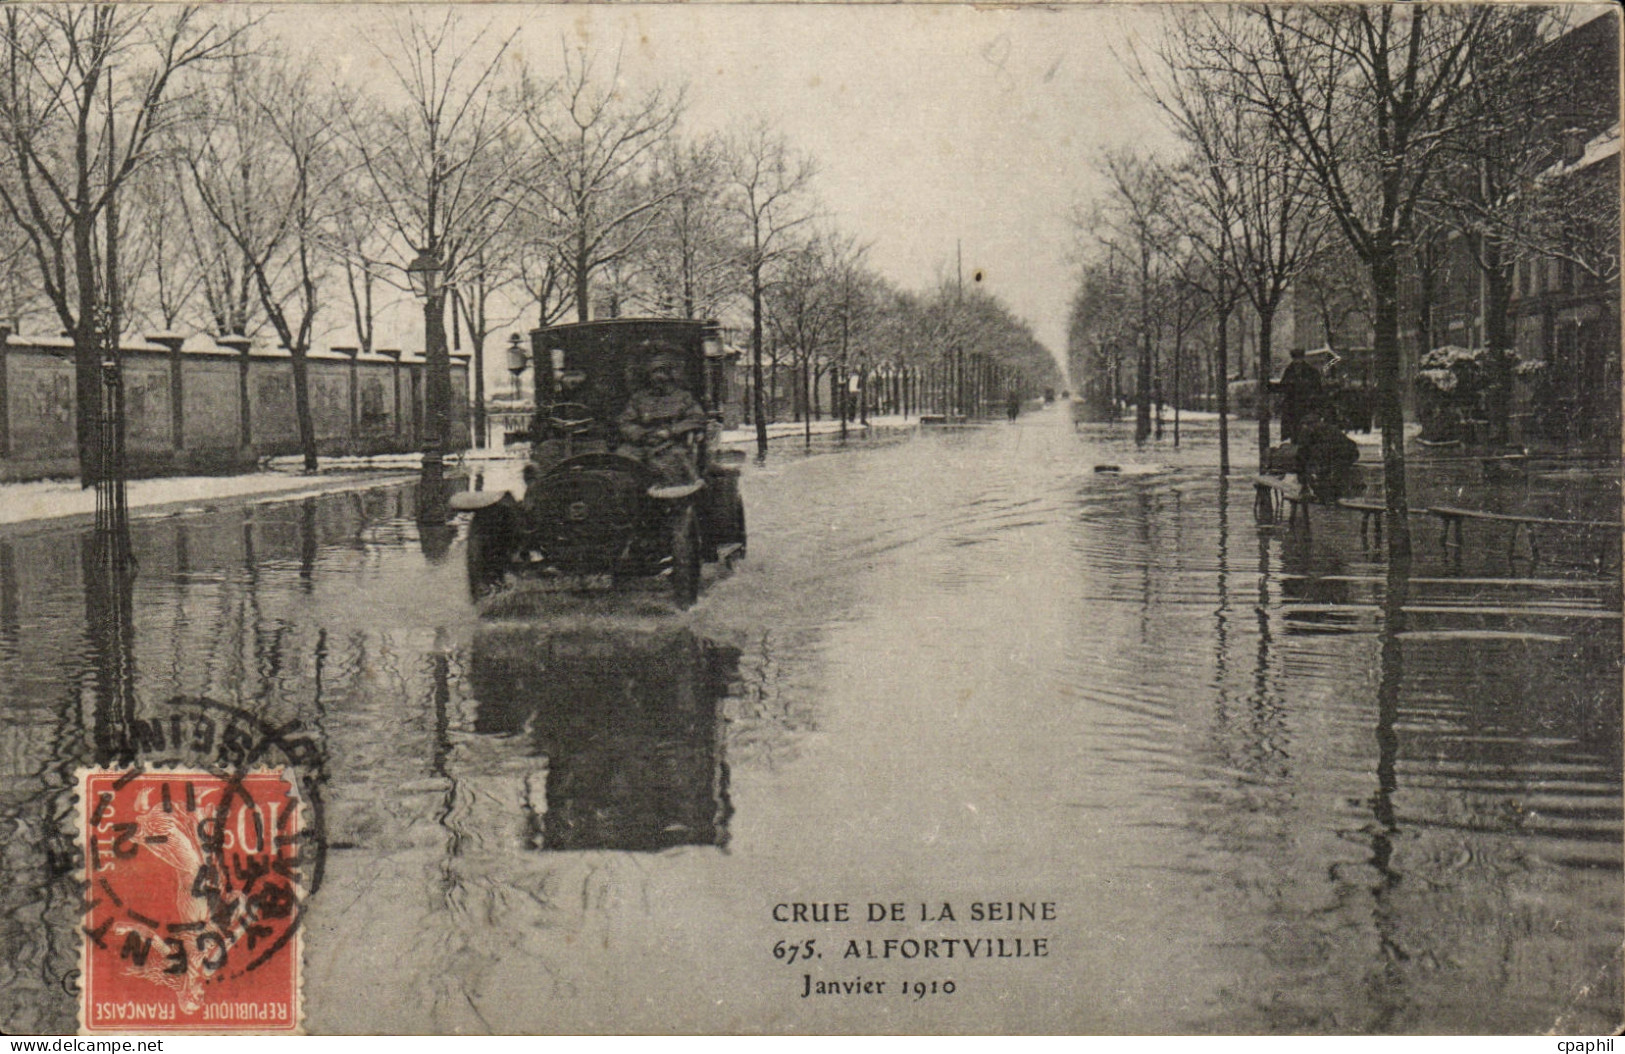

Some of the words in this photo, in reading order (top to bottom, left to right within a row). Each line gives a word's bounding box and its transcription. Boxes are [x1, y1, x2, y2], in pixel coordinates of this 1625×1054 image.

[96, 789, 115, 873] POSTES
[96, 1002, 176, 1020] FRANÇAISE
[202, 1002, 287, 1020] REPUBLIQUE
